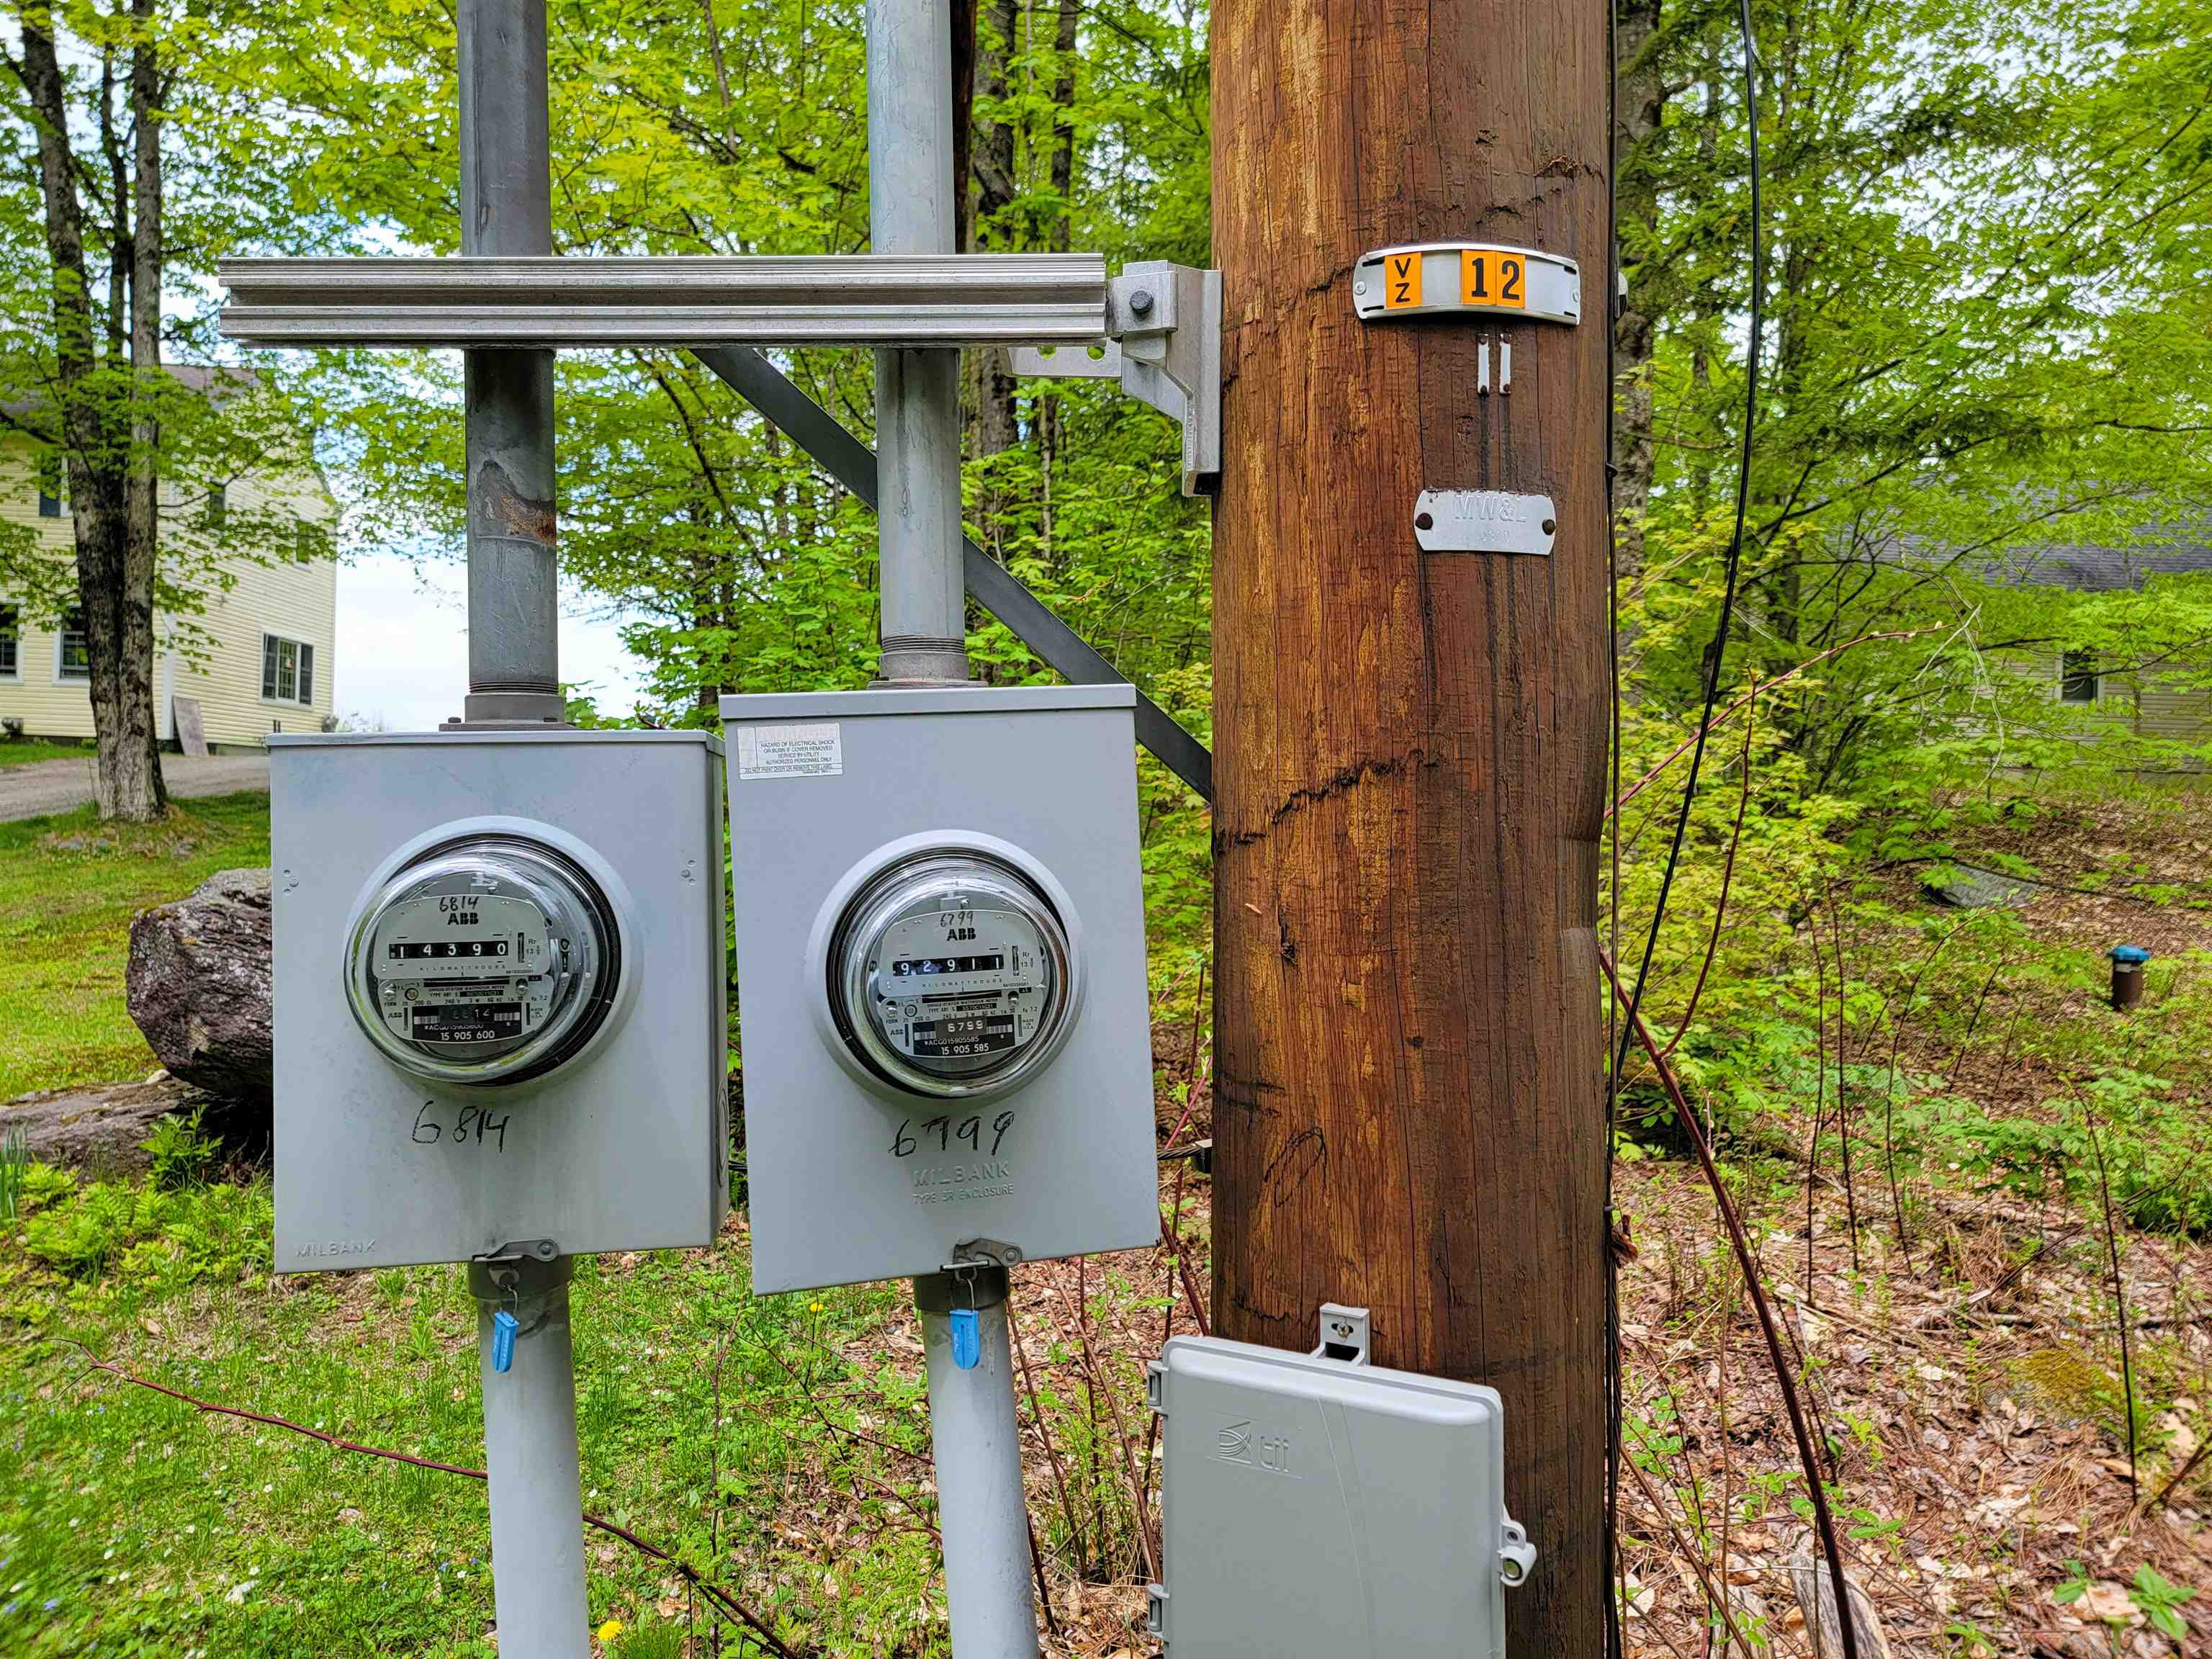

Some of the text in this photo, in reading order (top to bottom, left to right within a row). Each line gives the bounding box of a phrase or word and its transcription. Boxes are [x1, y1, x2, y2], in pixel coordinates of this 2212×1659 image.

[1470, 257, 1521, 301] 12
[439, 896, 479, 912] 6814
[447, 912, 479, 925] ABB
[940, 911, 974, 927] 6799
[946, 927, 976, 941] ABB
[947, 1020, 984, 1033] 6799
[441, 1030, 495, 1040] 15 905 600
[941, 1043, 989, 1055] 15 905 585
[412, 1100, 511, 1154] 6814
[888, 1111, 1015, 1157] 6799
[913, 1160, 1010, 1187] MILBANK
[912, 1192, 937, 1205] TYPE
[959, 1183, 1015, 1200] ENCLOSURE
[295, 1238, 376, 1257] MILBANK
